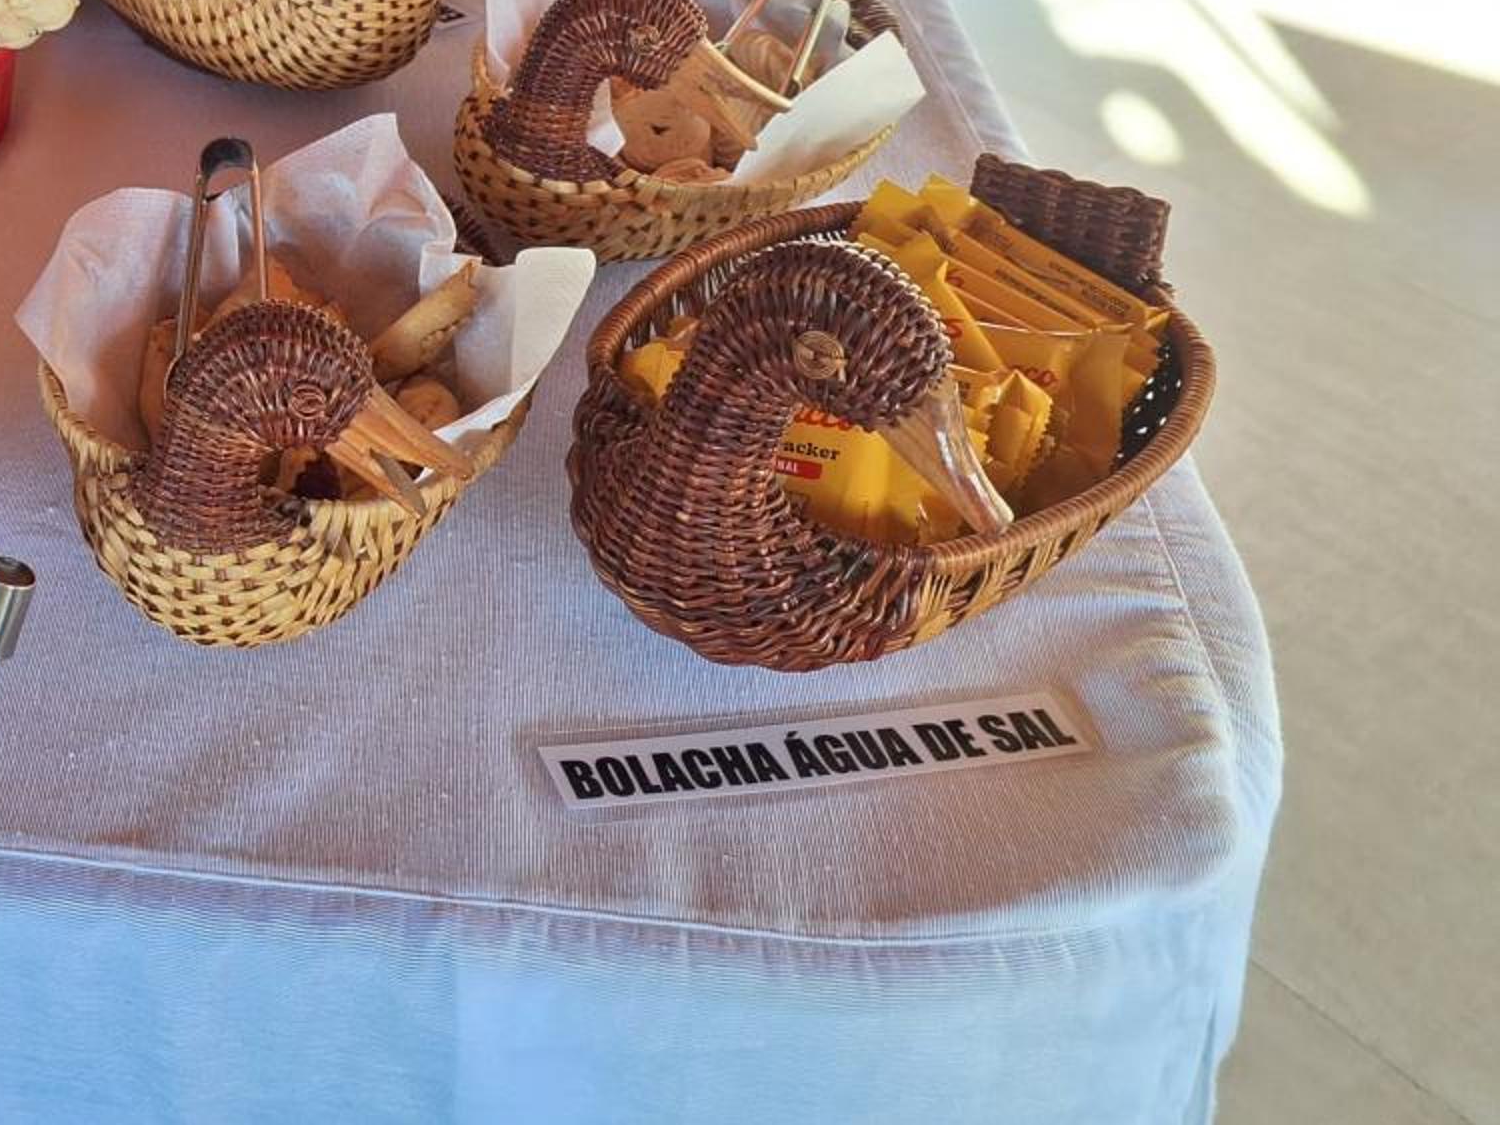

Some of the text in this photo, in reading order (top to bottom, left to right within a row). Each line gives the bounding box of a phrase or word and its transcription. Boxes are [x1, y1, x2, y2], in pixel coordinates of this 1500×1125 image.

[783, 441, 841, 461] acker
[559, 708, 1078, 801] BOLACHA ÁGUA DE SAL
